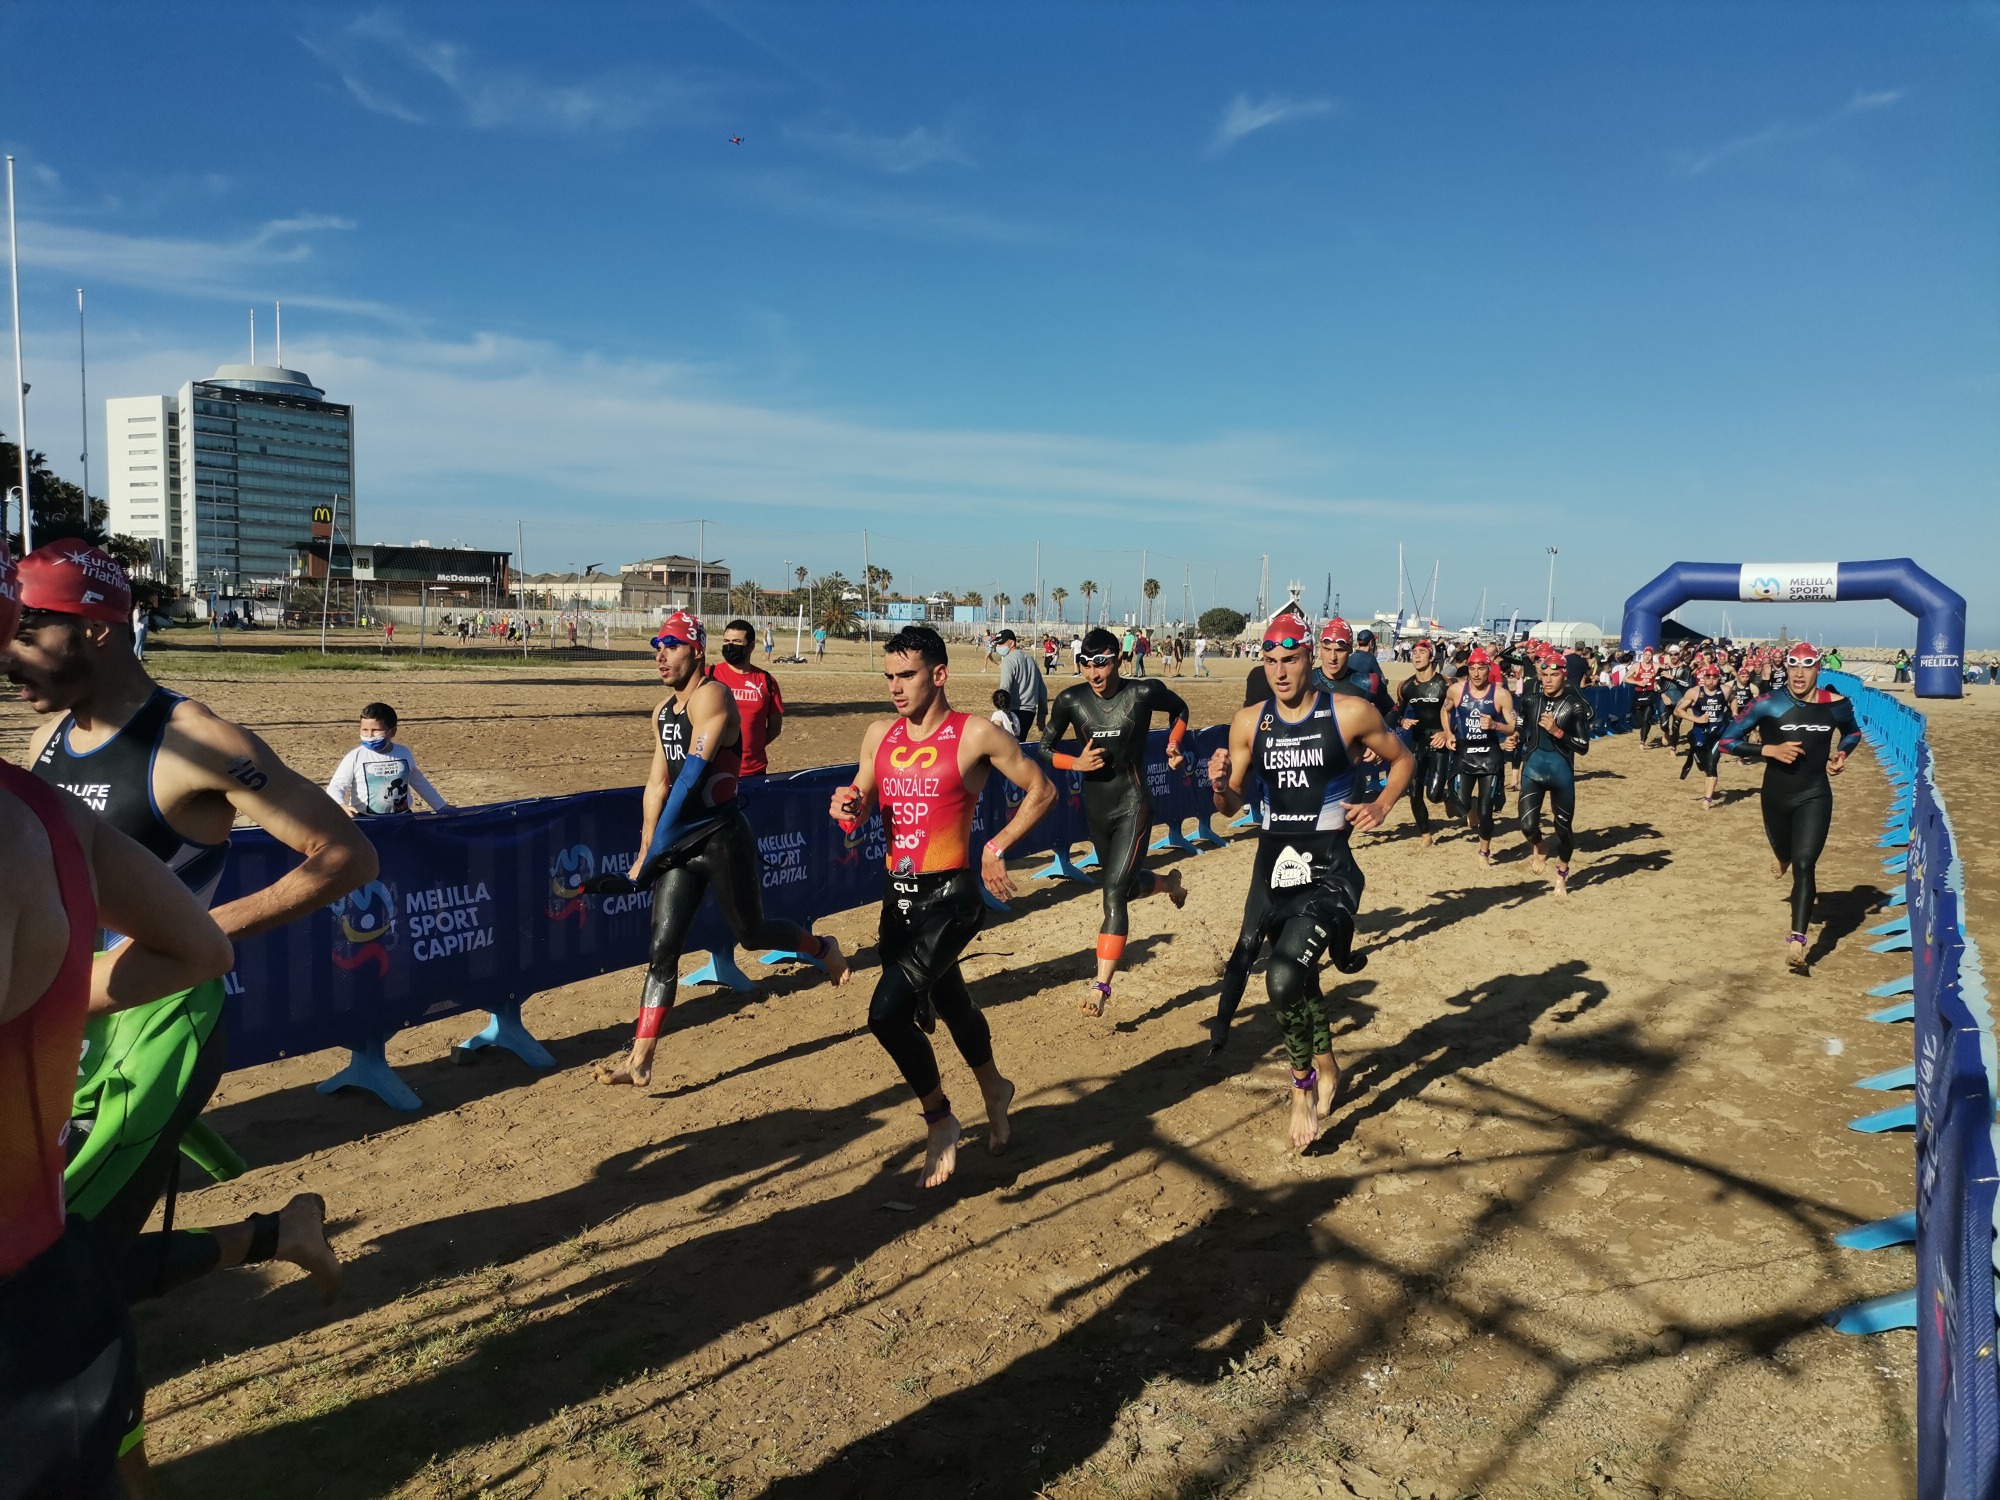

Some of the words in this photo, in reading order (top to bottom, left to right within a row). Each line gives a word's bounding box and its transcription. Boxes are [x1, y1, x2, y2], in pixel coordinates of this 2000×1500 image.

[437, 574, 491, 583] McDonald's
[1789, 577, 1834, 586] MELILLA
[1789, 586, 1825, 595] SPORT
[1920, 659, 1959, 668] MELILLA
[1465, 718, 1480, 727] SOLD
[663, 744, 687, 761] TUR
[1263, 748, 1324, 770] LESSMANN
[882, 774, 940, 797] GONZÁLEZ
[1147, 774, 1166, 785] SPORT
[1278, 770, 1310, 789] FRA
[892, 802, 929, 825] ESP
[757, 831, 807, 852] MELILLA
[762, 849, 802, 871] SPORT
[762, 865, 808, 888] CAPITAL
[406, 882, 491, 914] MELILLA
[409, 907, 478, 938] SPORT
[413, 926, 494, 962] CAPITAL
